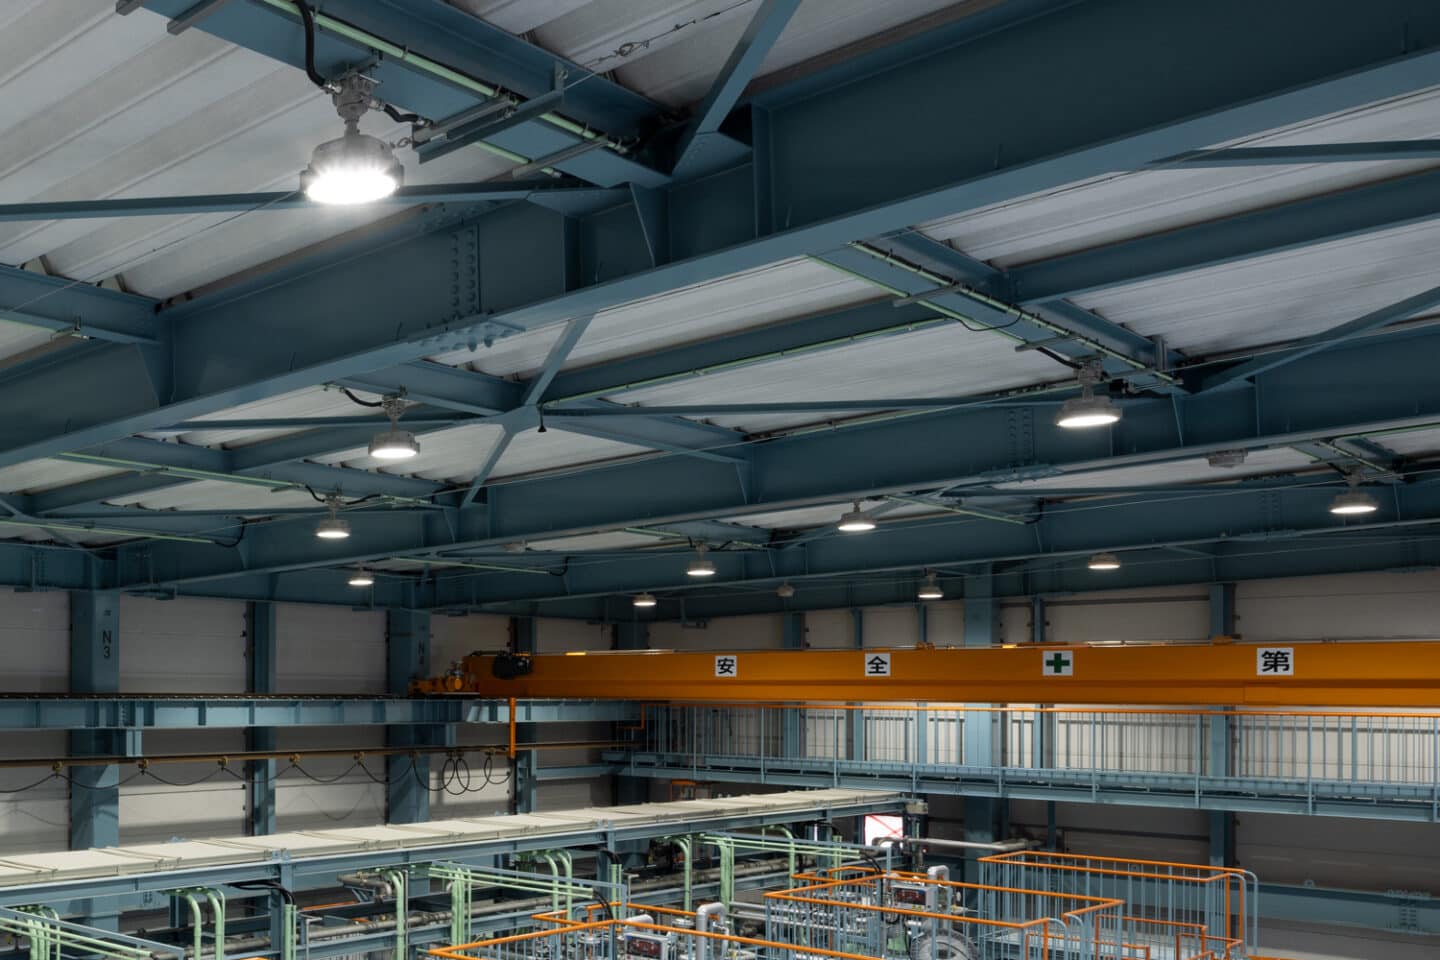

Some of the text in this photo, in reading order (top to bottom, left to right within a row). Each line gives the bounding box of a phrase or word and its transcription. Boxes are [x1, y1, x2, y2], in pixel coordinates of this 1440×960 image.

[717, 650, 1291, 675] 安 全 第
